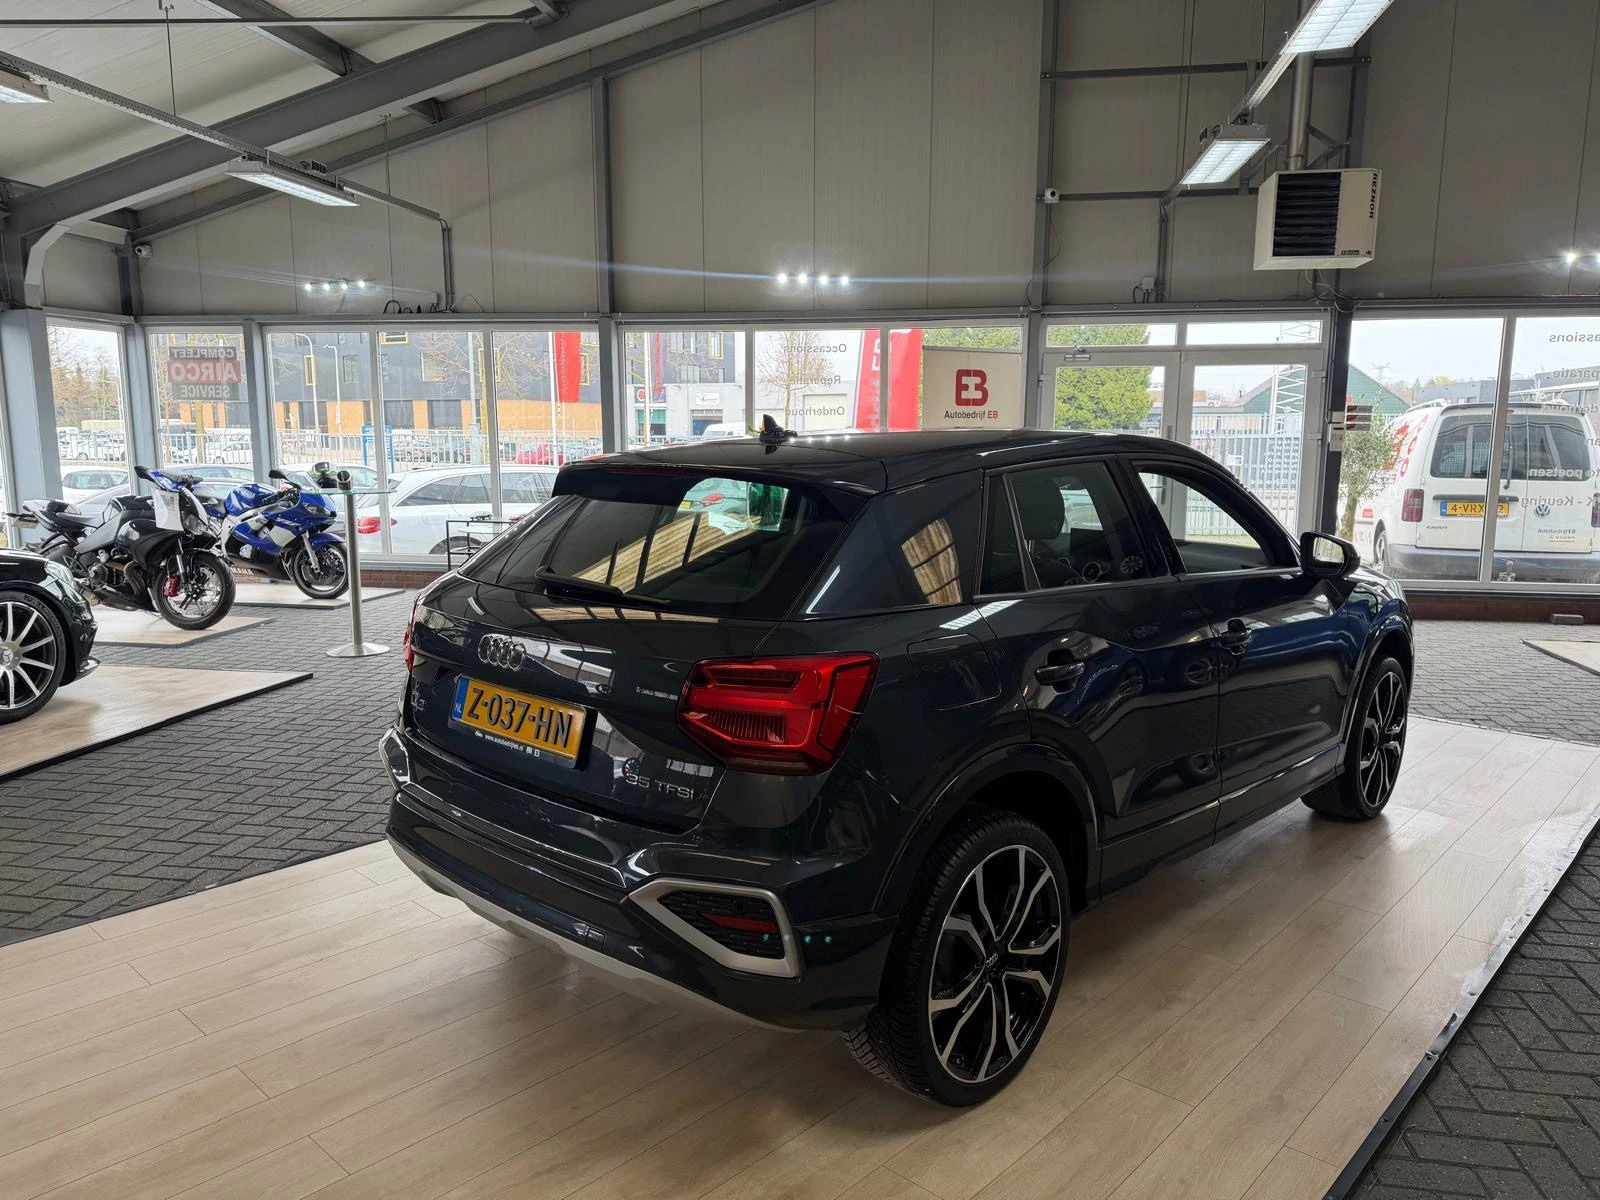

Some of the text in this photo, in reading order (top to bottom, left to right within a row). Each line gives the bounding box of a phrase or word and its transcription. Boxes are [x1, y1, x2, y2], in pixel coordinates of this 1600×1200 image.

[1369, 173, 1378, 219] REZNOR
[944, 411, 999, 421] Autobedrijf EB
[467, 687, 574, 748] Z-037-HN
[626, 773, 694, 800] 35 TFSI
